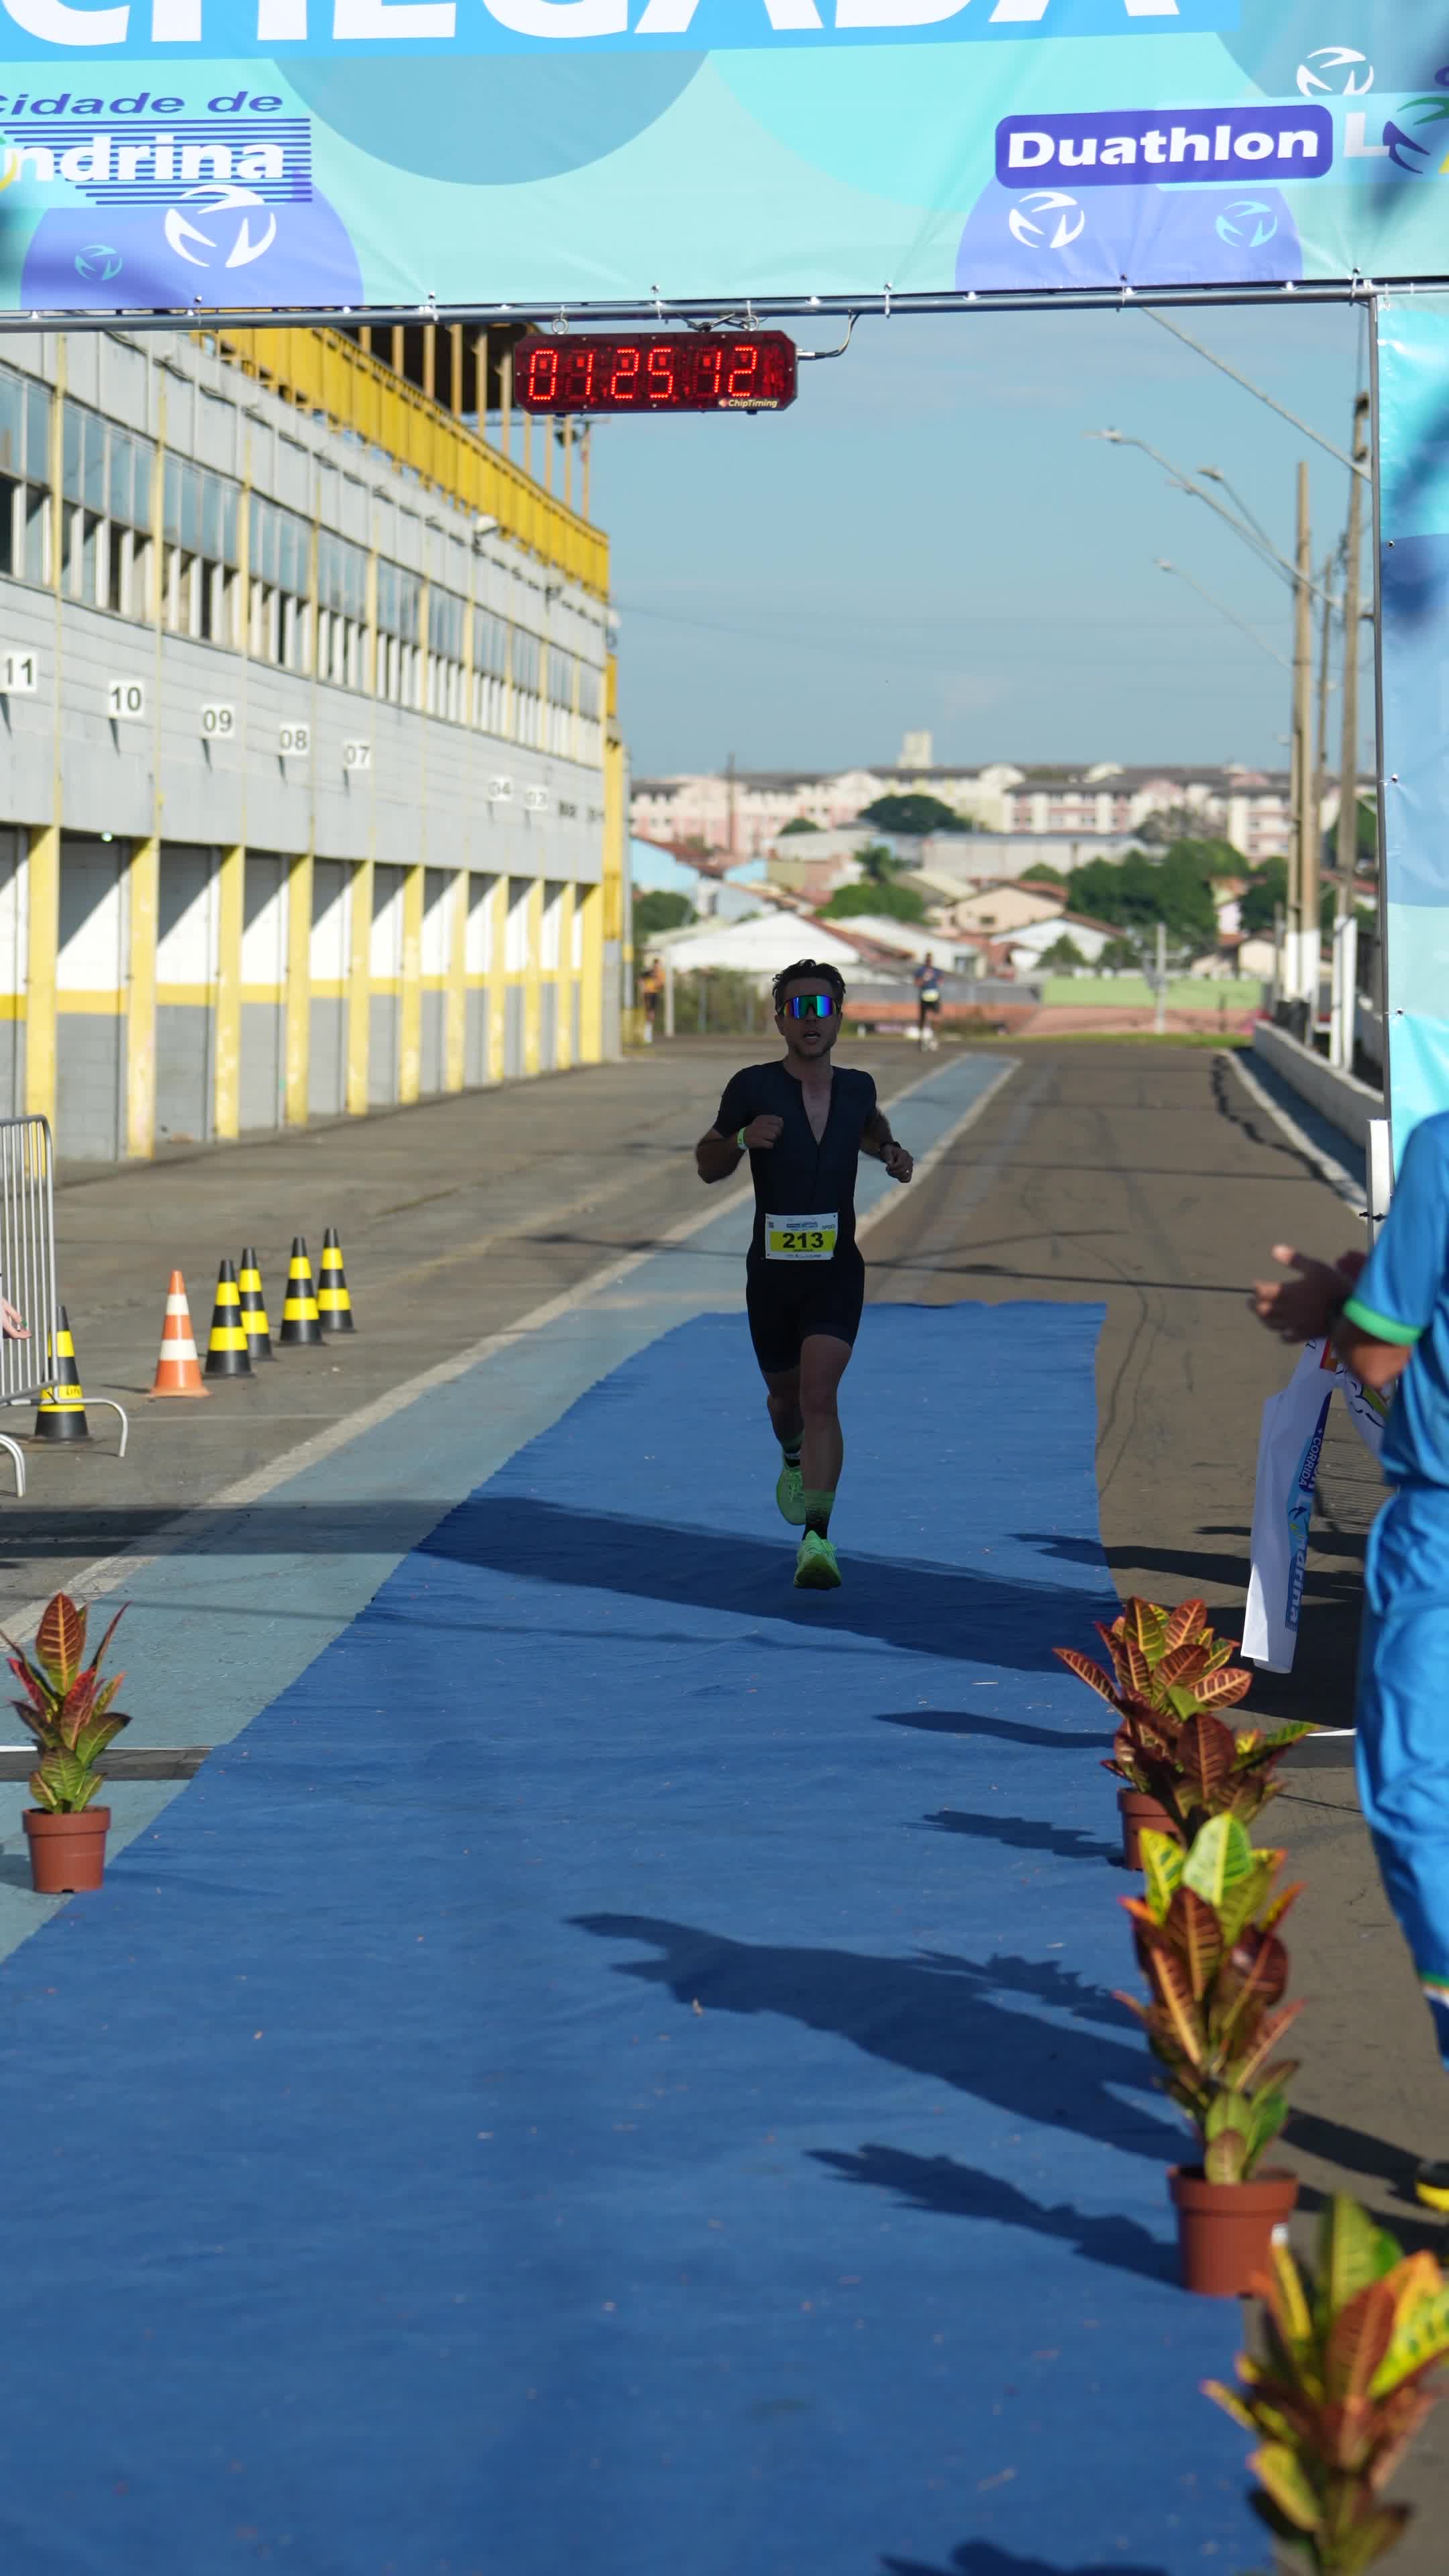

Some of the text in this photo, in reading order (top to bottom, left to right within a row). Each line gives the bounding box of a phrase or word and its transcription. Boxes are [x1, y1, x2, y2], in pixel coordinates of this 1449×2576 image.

[207, 91, 283, 113] de
[1007, 125, 1319, 168] Duathlon
[728, 398, 778, 408] ChipTiming
[5, 657, 33, 685] 11
[111, 686, 142, 711] 10
[203, 709, 233, 733] 09
[279, 729, 307, 750] 08
[344, 745, 371, 765] 07
[783, 1232, 824, 1248] 213
[1298, 1438, 1322, 1486] CORRIDA
